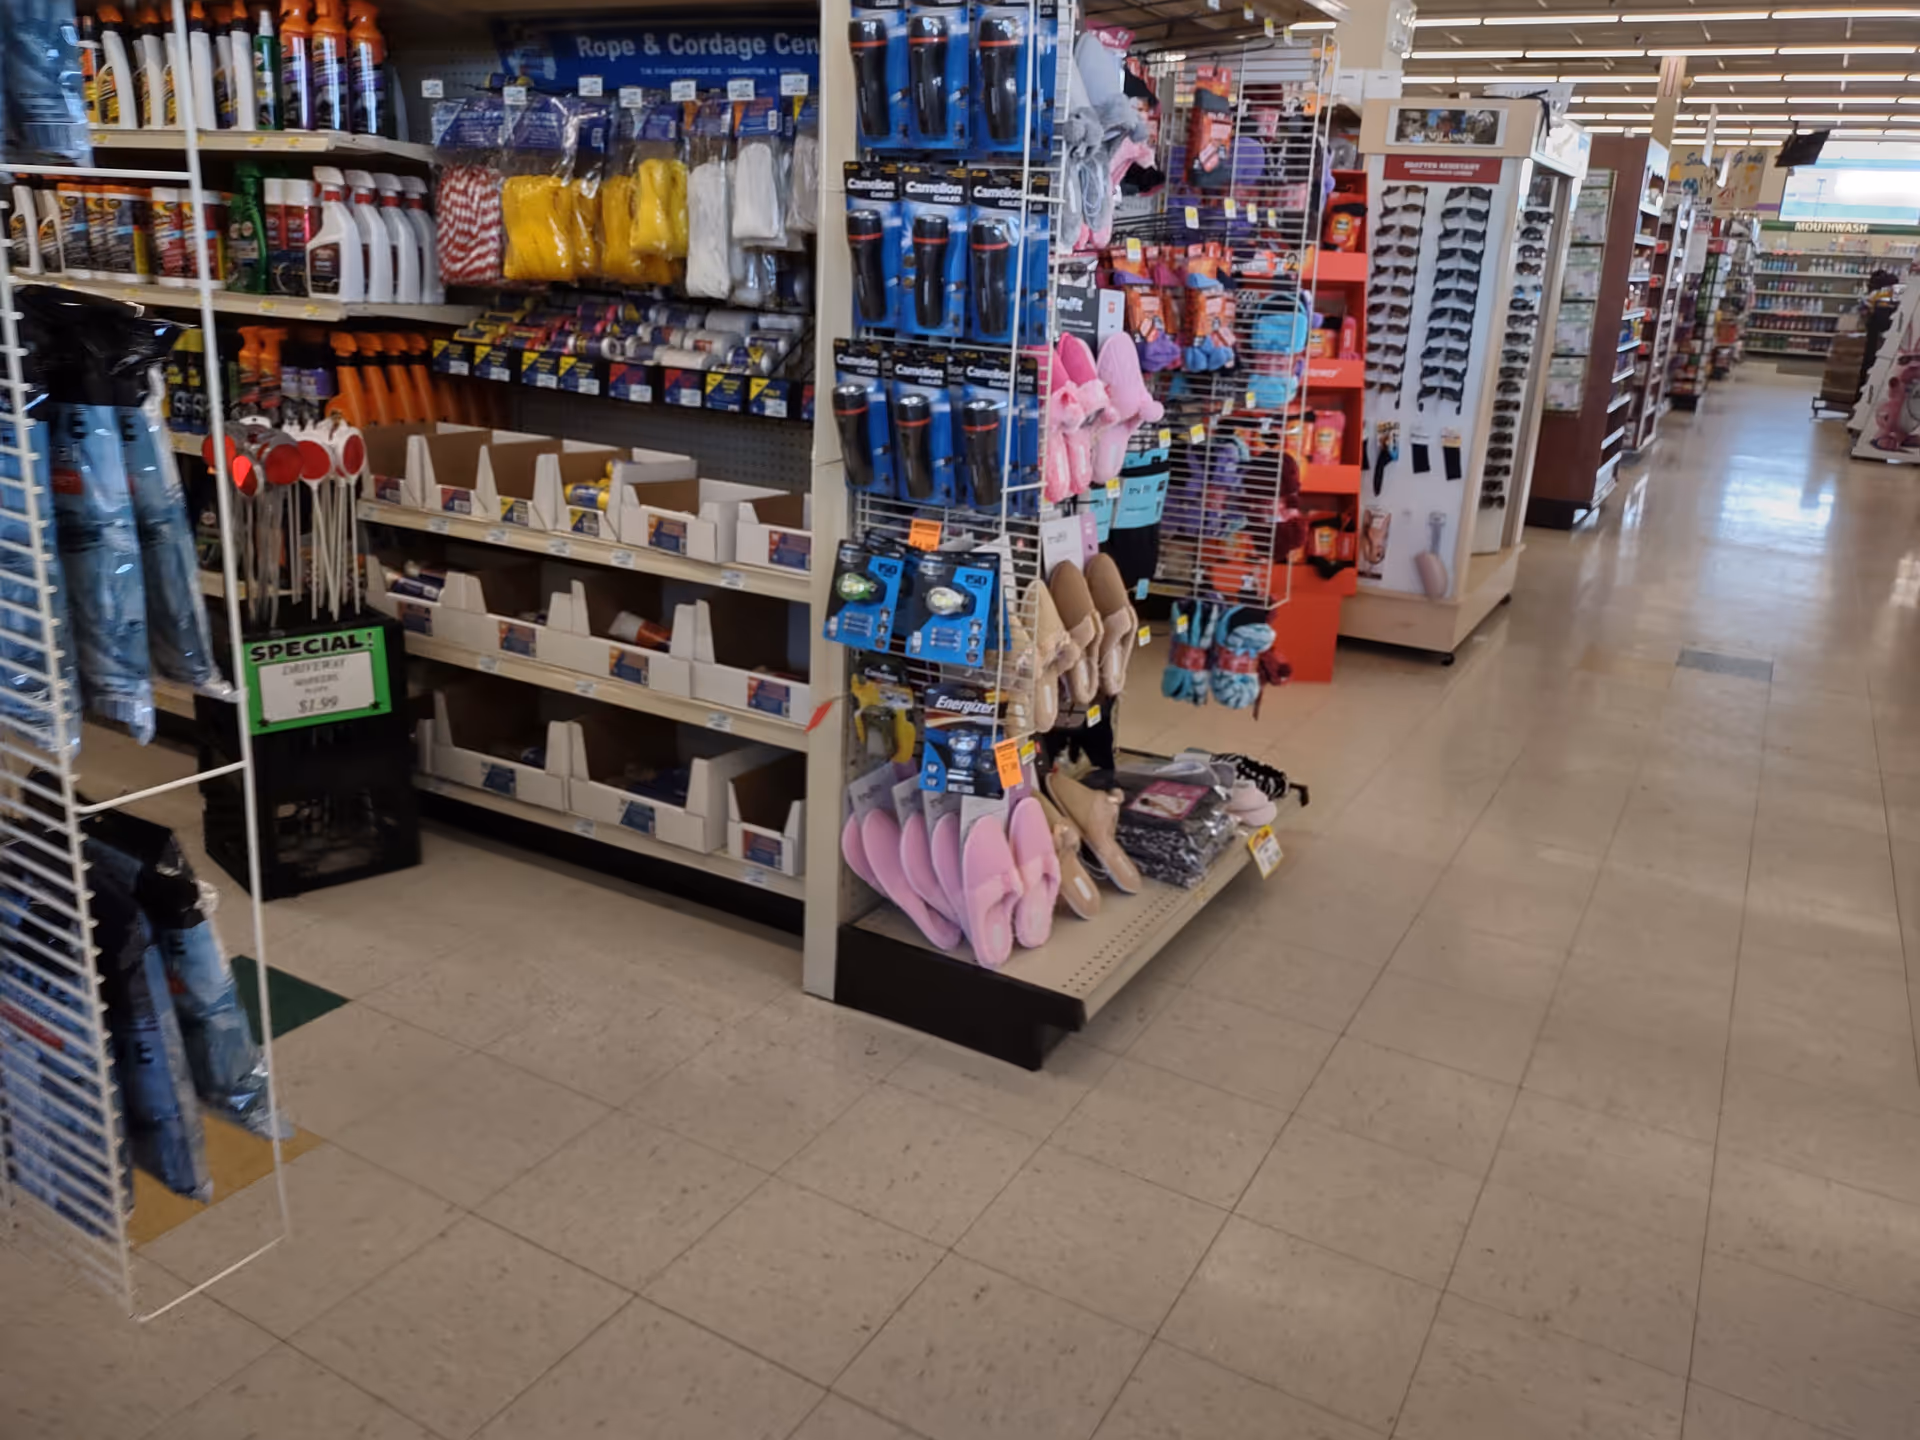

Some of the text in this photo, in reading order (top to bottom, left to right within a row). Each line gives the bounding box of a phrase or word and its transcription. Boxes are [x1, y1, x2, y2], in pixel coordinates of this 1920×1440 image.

[577, 32, 819, 61] Rope & Cordage Cen
[847, 177, 895, 190] Camelion
[905, 180, 963, 195] Camelion
[973, 185, 1023, 199] Camelion
[1794, 221, 1868, 234] MOUTHWASH
[836, 353, 879, 368] Camelion
[895, 363, 944, 378] Camelion
[966, 365, 1012, 380] Camelion
[935, 695, 996, 715] Energizer
